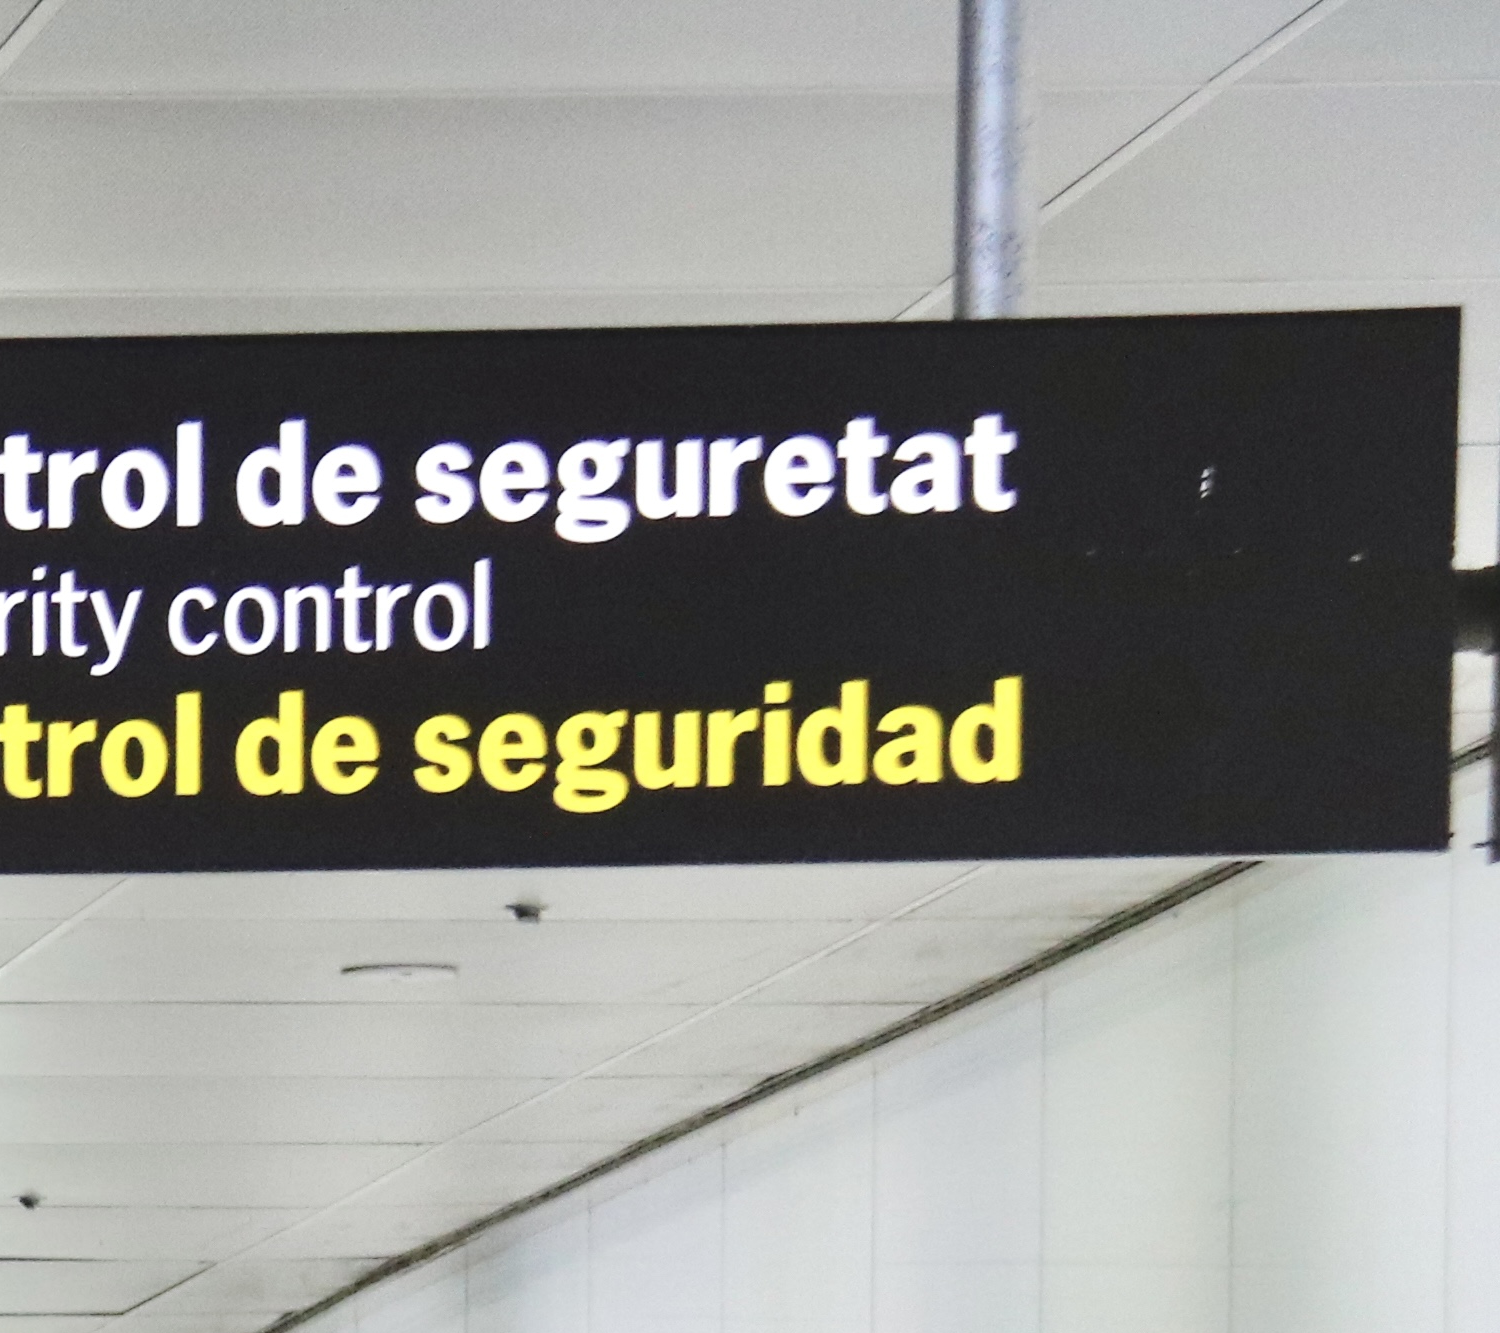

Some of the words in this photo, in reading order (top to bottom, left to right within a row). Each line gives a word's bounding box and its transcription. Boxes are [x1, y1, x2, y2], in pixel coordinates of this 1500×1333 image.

[237, 419, 382, 527] de
[415, 414, 1017, 545] seguretat
[168, 558, 491, 655] control
[235, 690, 380, 795] de
[414, 677, 1021, 813] seguridad
